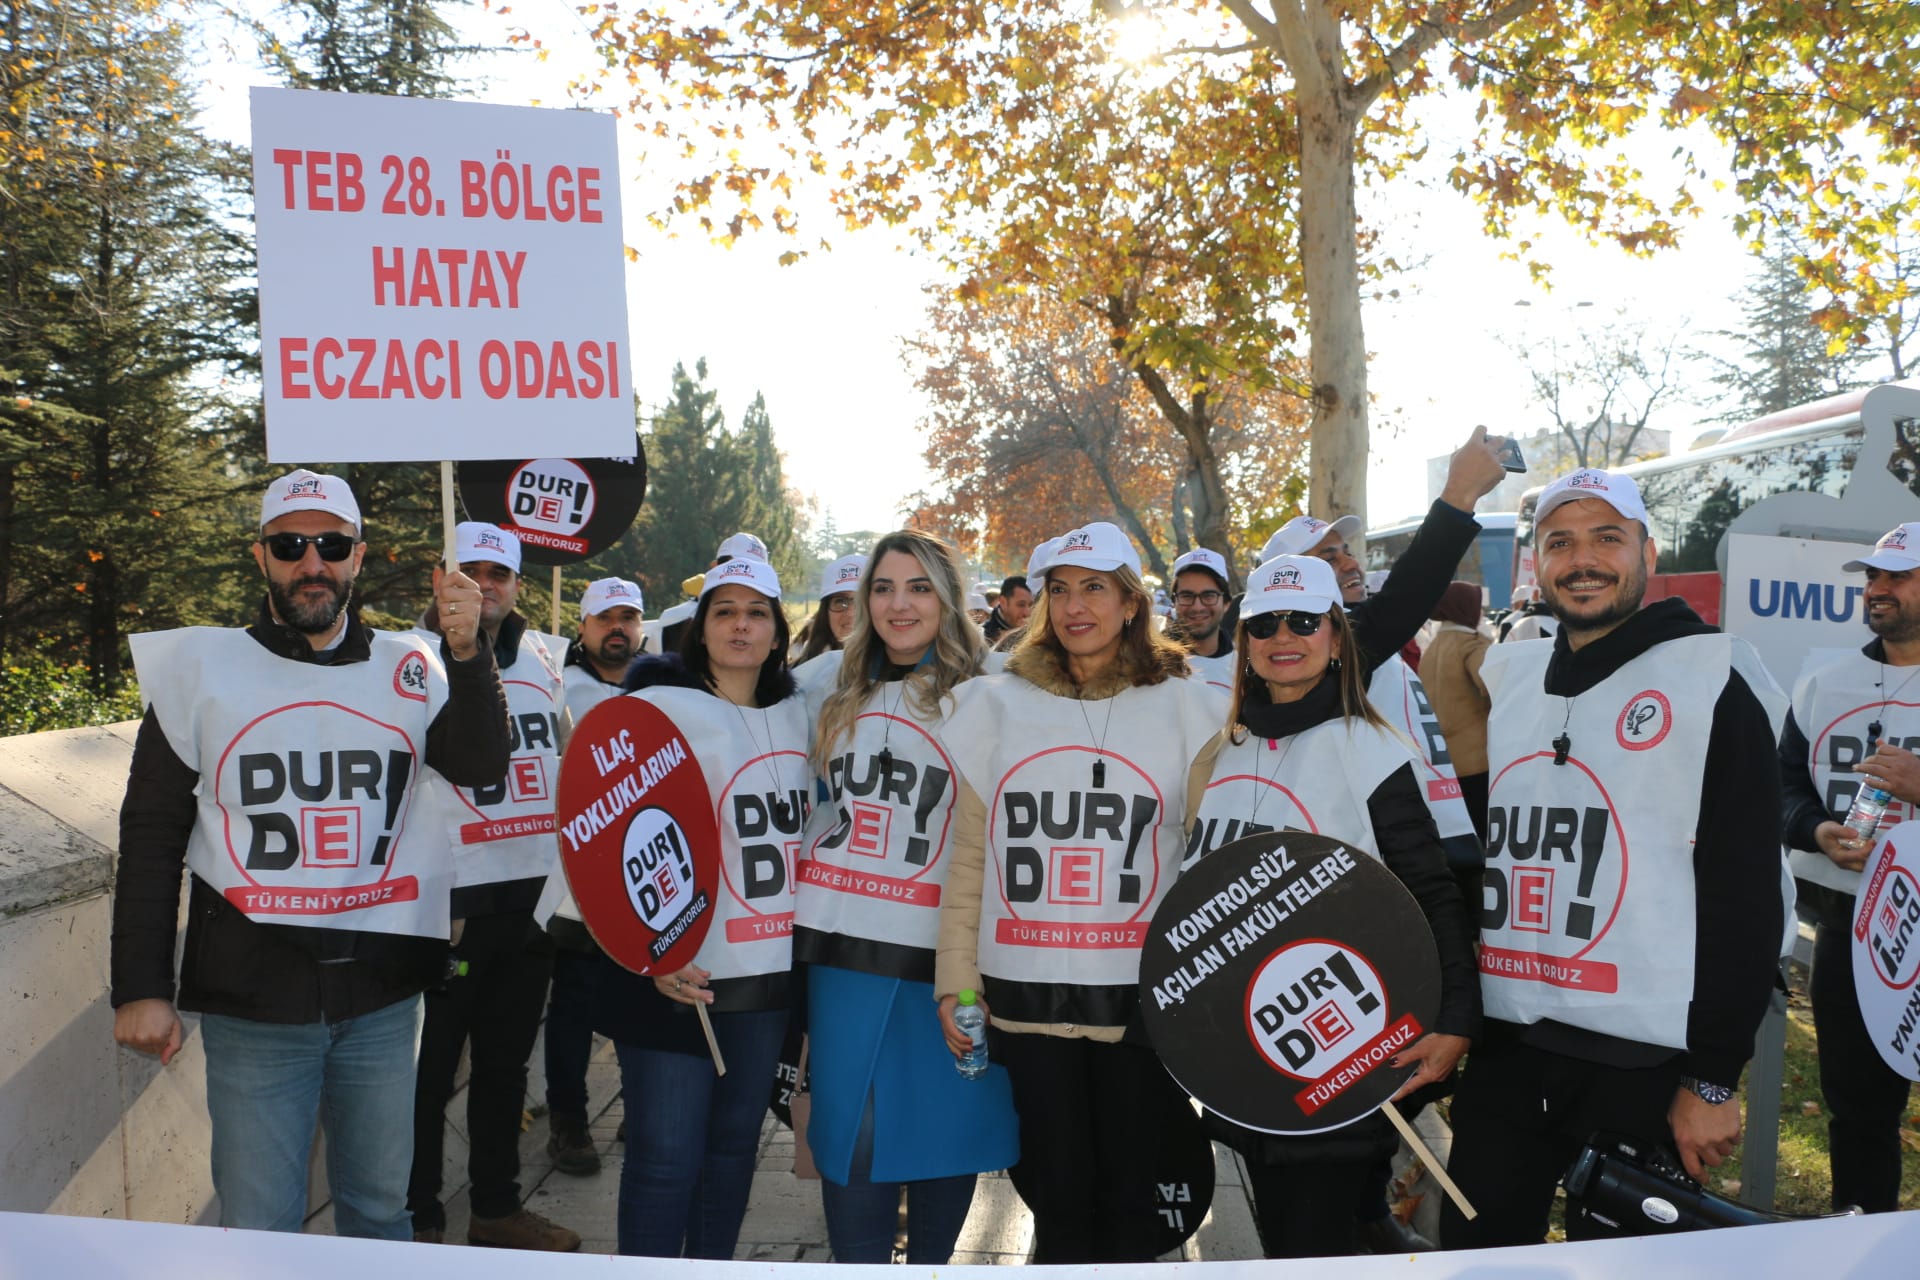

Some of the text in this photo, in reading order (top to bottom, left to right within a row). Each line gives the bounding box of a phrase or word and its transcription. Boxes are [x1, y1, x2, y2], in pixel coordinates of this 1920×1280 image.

[273, 148, 603, 224] TEB 28. BÖLGE
[372, 246, 528, 309] HATAY
[279, 337, 620, 400] ECZACI ODASI
[519, 470, 574, 497] DUR
[239, 749, 383, 807] DUR
[590, 729, 635, 777] İLAÇ
[561, 737, 687, 852] YOKLUKLARINA
[1003, 791, 1127, 842] DUR
[625, 830, 672, 885] DUR
[1485, 805, 1579, 863] DUR
[245, 886, 393, 910] TÜKENİYORUZ
[804, 866, 916, 900] TÜKENİYORUZ
[1164, 846, 1297, 953] KONTROLSÜZ
[652, 895, 708, 957] TÜKENİYORUZ
[1012, 926, 1138, 944] TÜKENİYORUZ
[1152, 846, 1357, 1011] AÇILAN FAKÜLTELERE
[1253, 966, 1338, 1036] DUR
[1306, 1023, 1415, 1108] TÜKENİYORUZ
